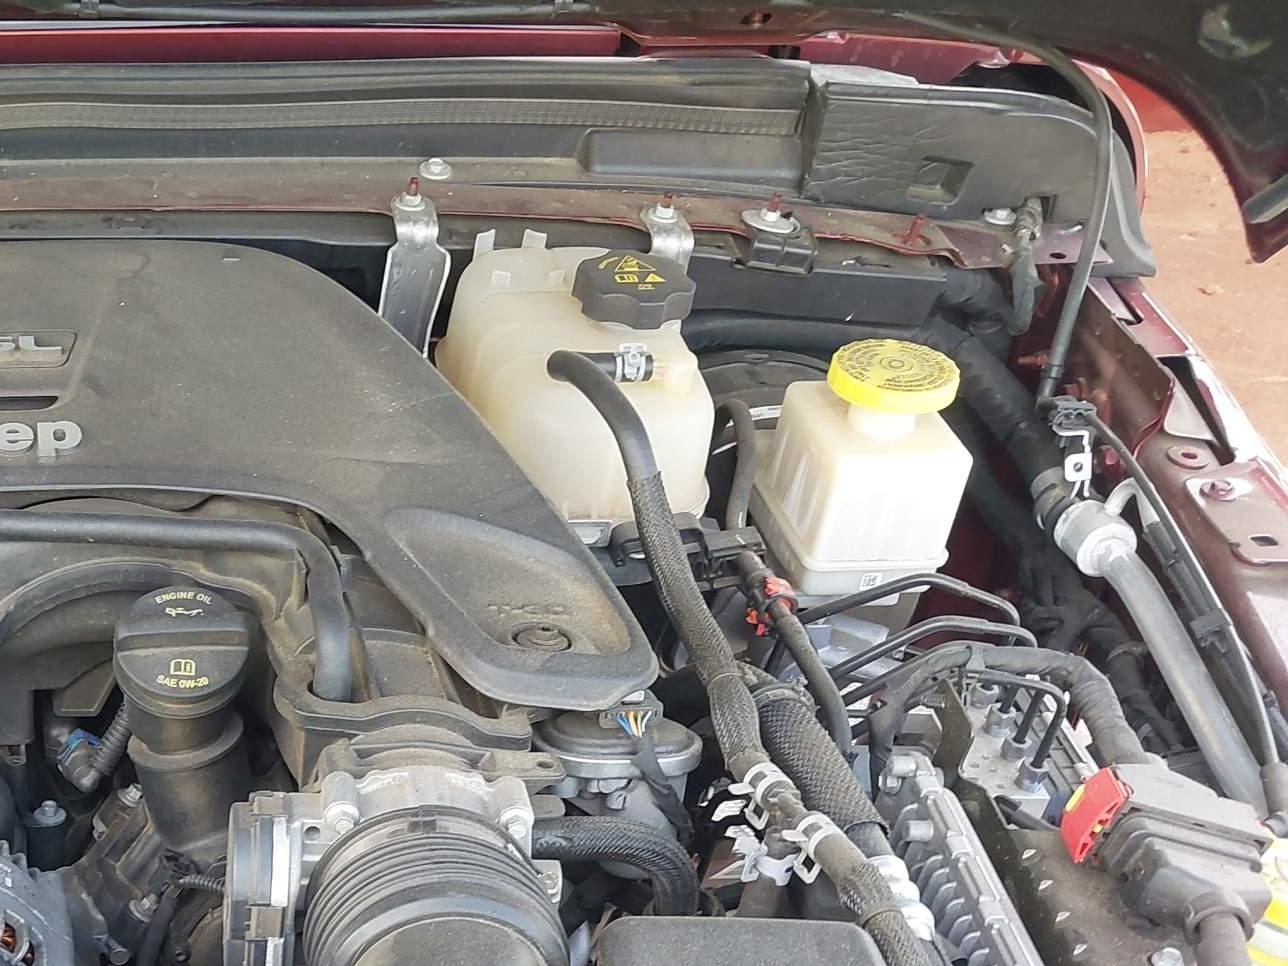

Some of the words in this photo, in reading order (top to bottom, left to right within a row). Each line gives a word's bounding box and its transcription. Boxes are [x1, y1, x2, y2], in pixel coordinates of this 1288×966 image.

[154, 591, 194, 605] ENGINE
[196, 592, 213, 605] OIL
[156, 674, 178, 688] SAE
[178, 676, 210, 689] 0W-20
